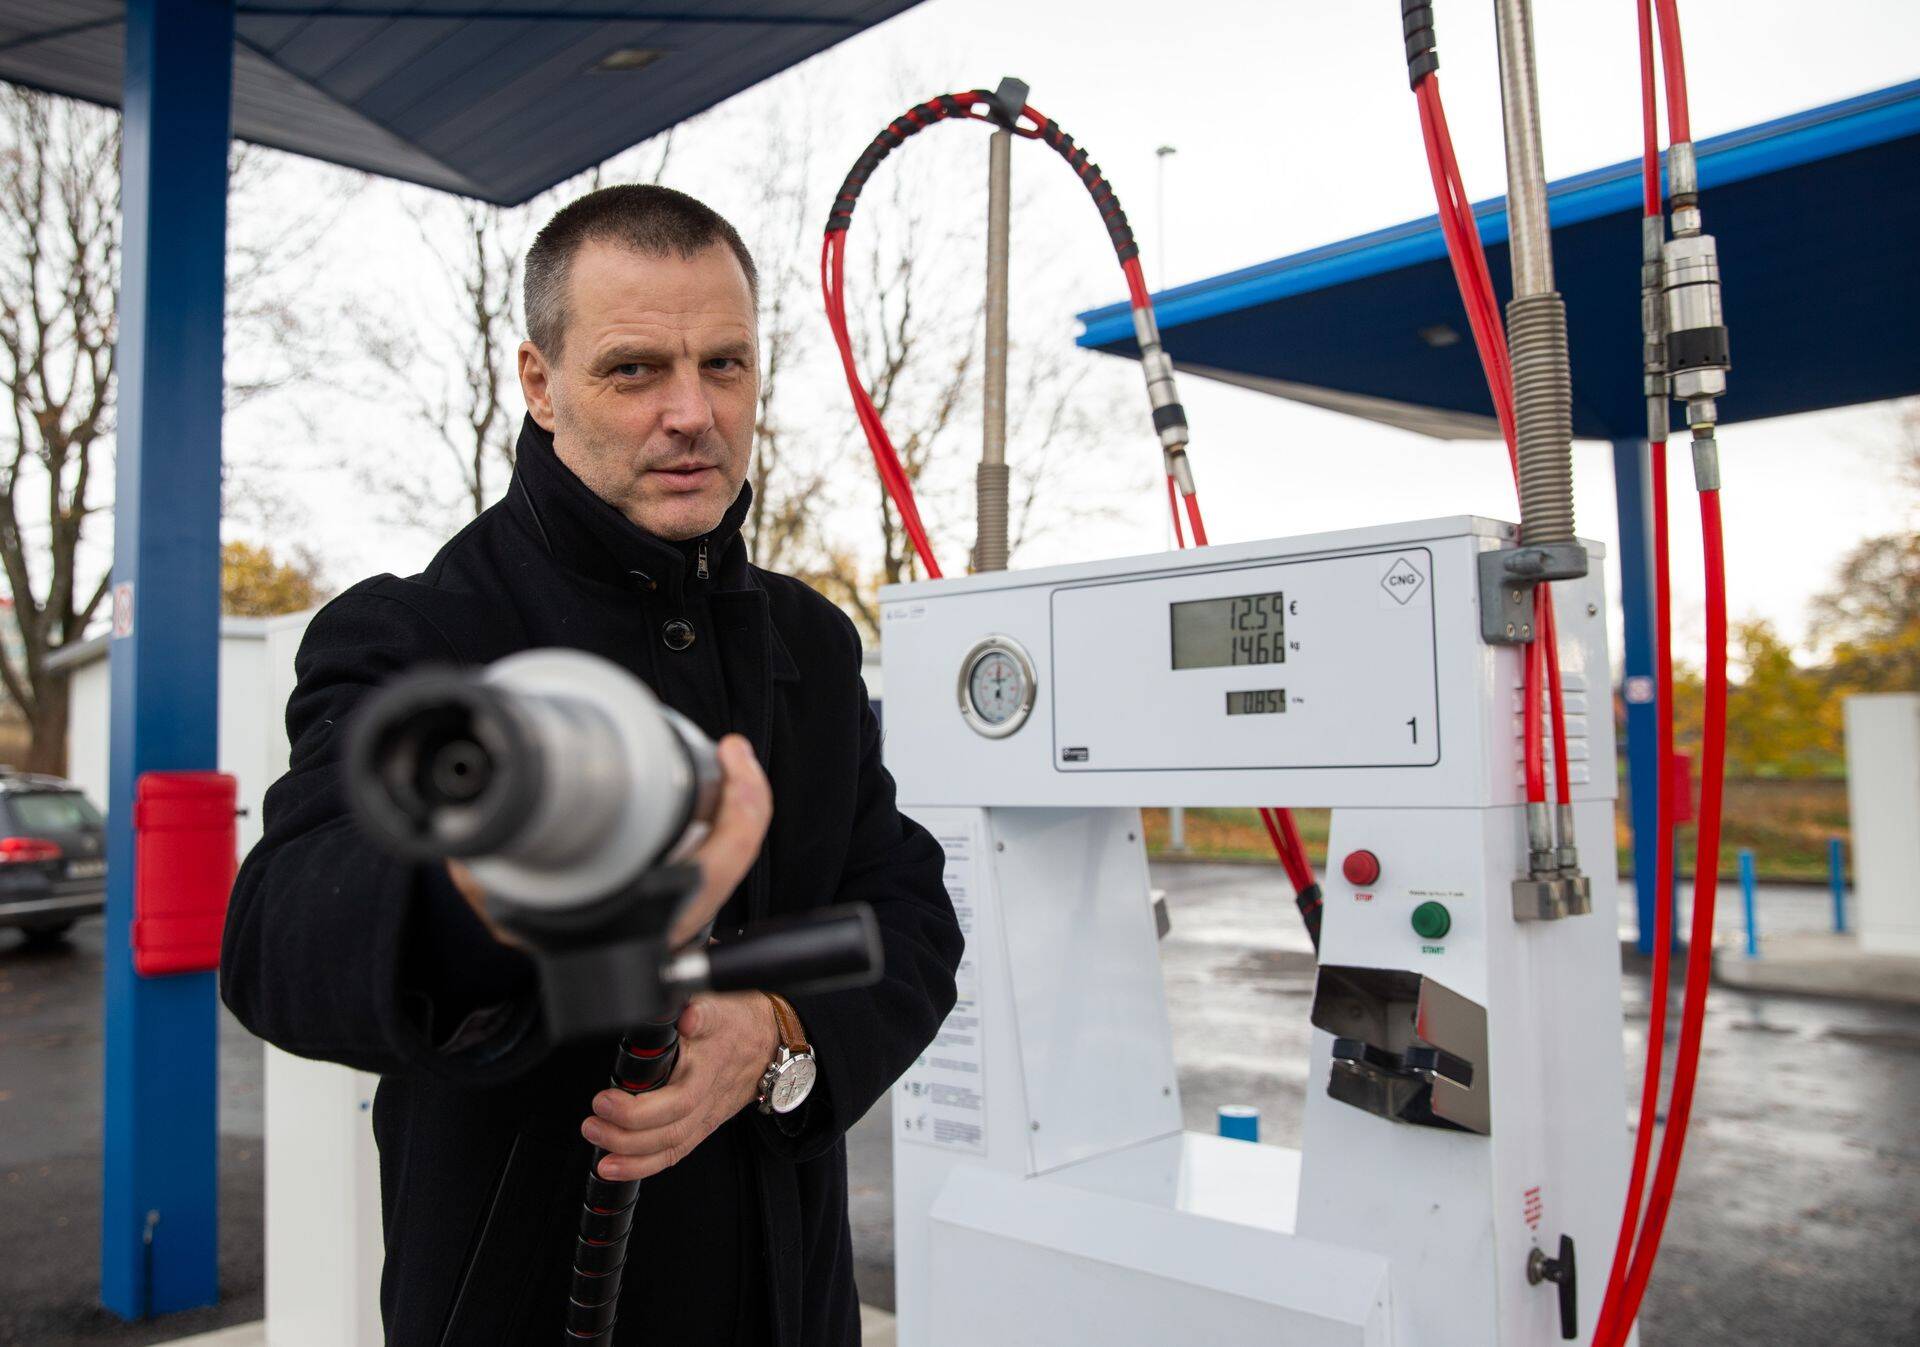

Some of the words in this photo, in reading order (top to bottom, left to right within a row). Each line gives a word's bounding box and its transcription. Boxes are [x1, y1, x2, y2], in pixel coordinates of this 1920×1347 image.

[1389, 574, 1416, 587] CNG
[1289, 600, 1298, 615] €
[1290, 641, 1300, 651] kg
[1407, 716, 1417, 744] 1
[1422, 946, 1445, 954] START
